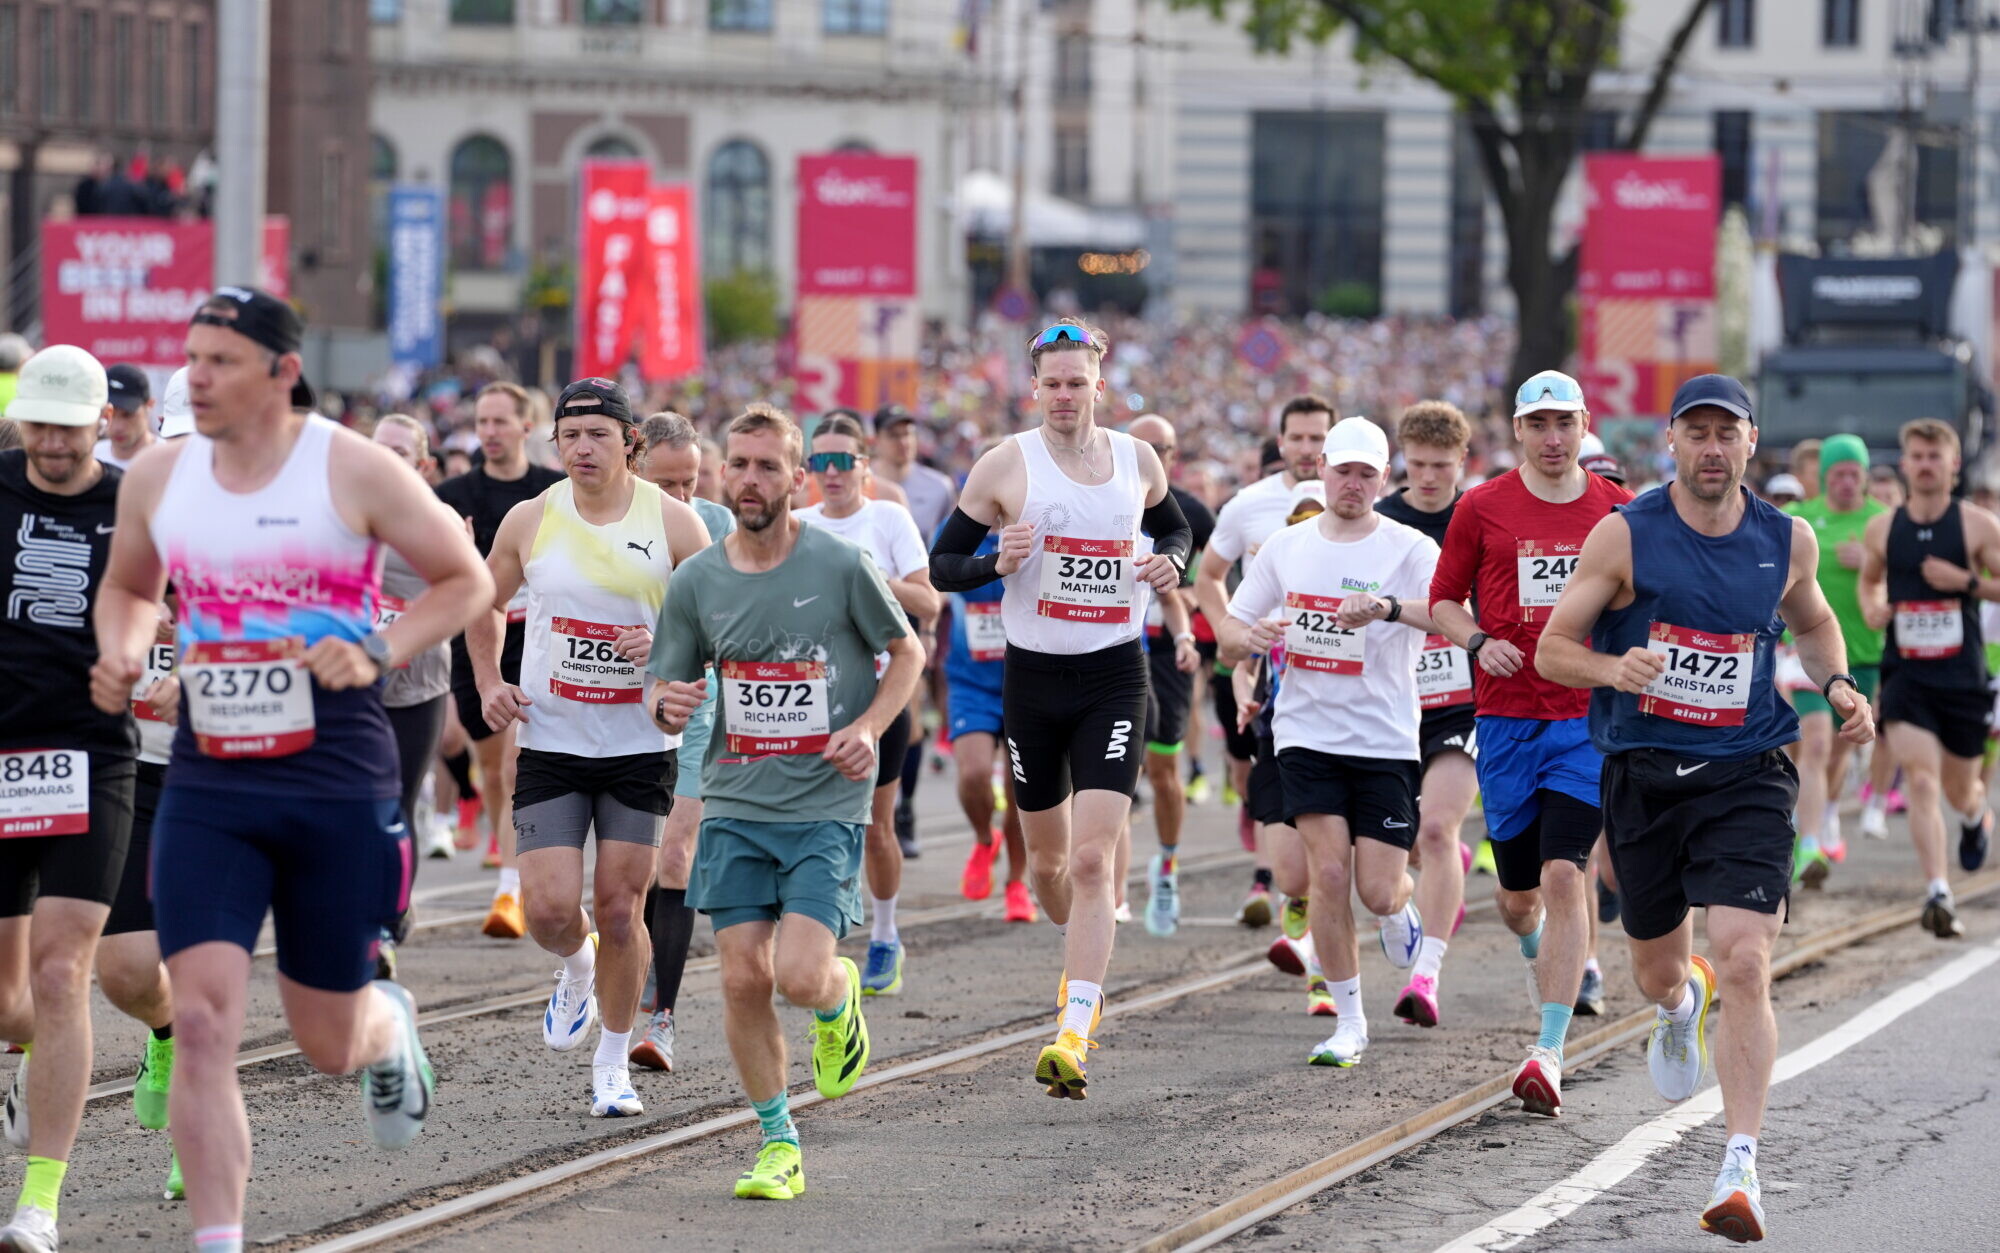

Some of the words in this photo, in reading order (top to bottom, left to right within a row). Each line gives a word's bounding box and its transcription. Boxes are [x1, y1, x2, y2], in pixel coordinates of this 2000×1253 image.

[76, 231, 174, 265] YOUR
[59, 261, 148, 293] BEST
[82, 291, 121, 321] IN
[1058, 556, 1121, 580] 3201
[1060, 581, 1117, 594] MATHIAS
[1341, 577, 1369, 590] BENU
[1545, 583, 1566, 593] HE
[561, 660, 635, 675] CHRISTOPHER
[1668, 647, 1739, 680] 1472
[197, 667, 292, 697] 2370
[1664, 675, 1735, 695] KRISTAPS
[738, 683, 813, 707] 3672
[744, 711, 808, 722] RICHARD
[0, 753, 72, 782] 848
